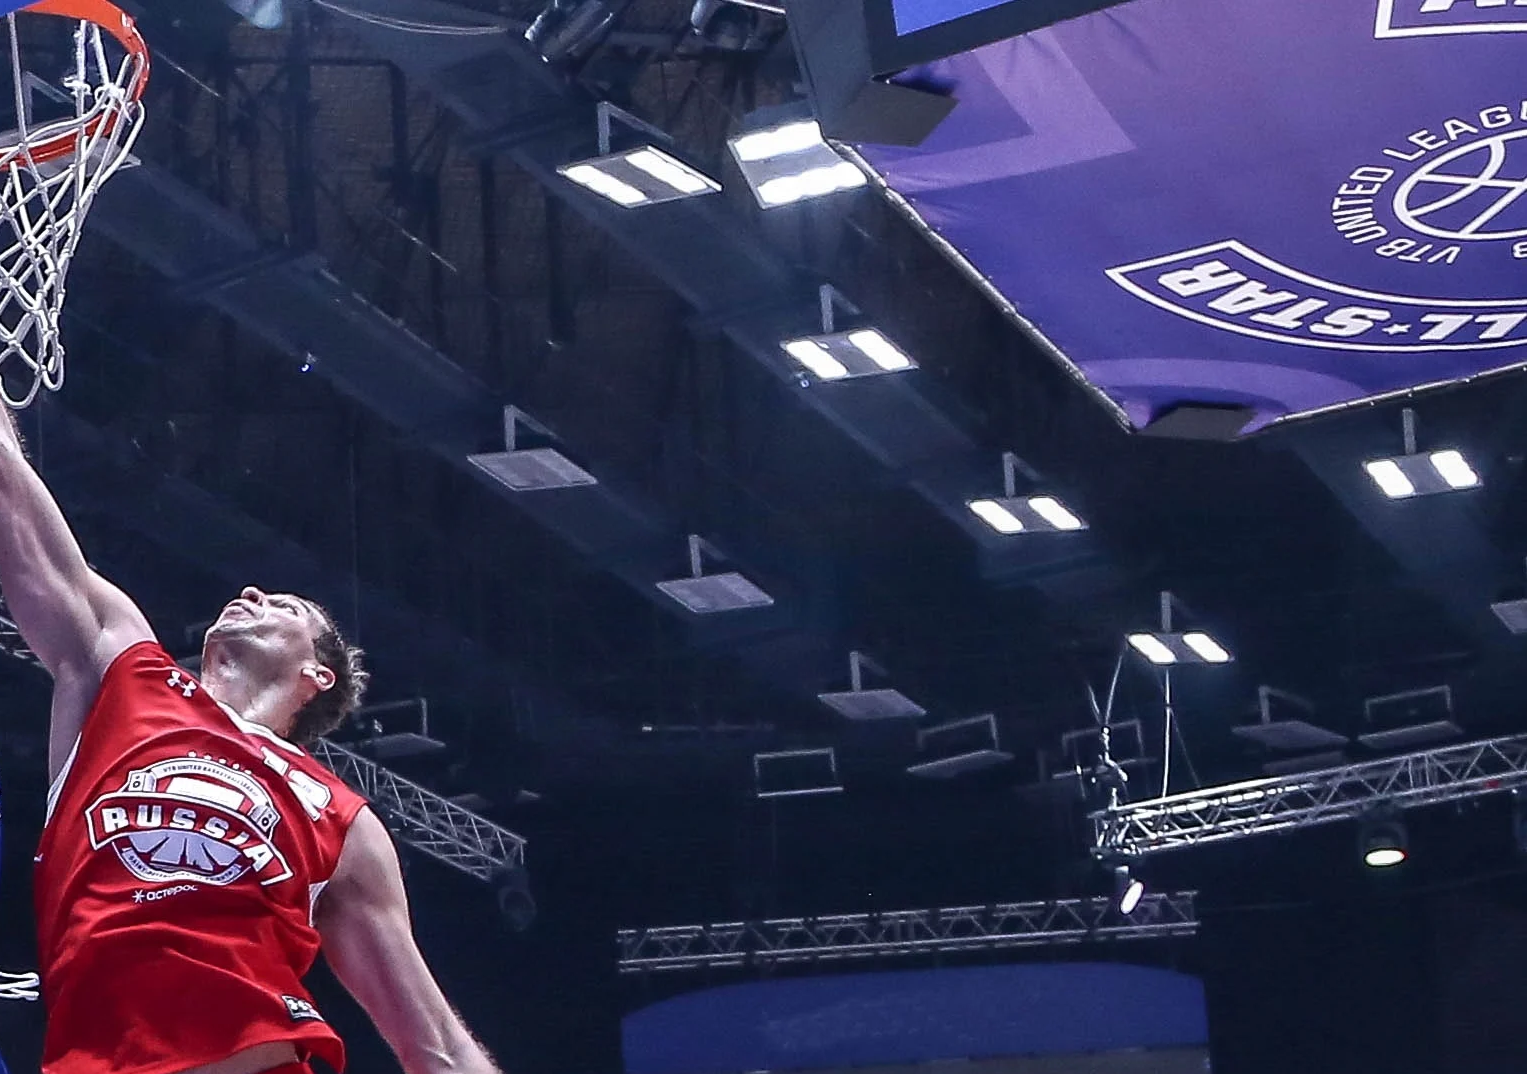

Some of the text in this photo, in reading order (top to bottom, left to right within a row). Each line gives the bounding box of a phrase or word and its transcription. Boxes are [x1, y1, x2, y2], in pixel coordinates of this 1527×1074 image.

[1382, 100, 1527, 162] LEAG
[1331, 164, 1395, 245] UNITED
[1375, 238, 1461, 264] VTB
[101, 803, 273, 873] RUSSIA
